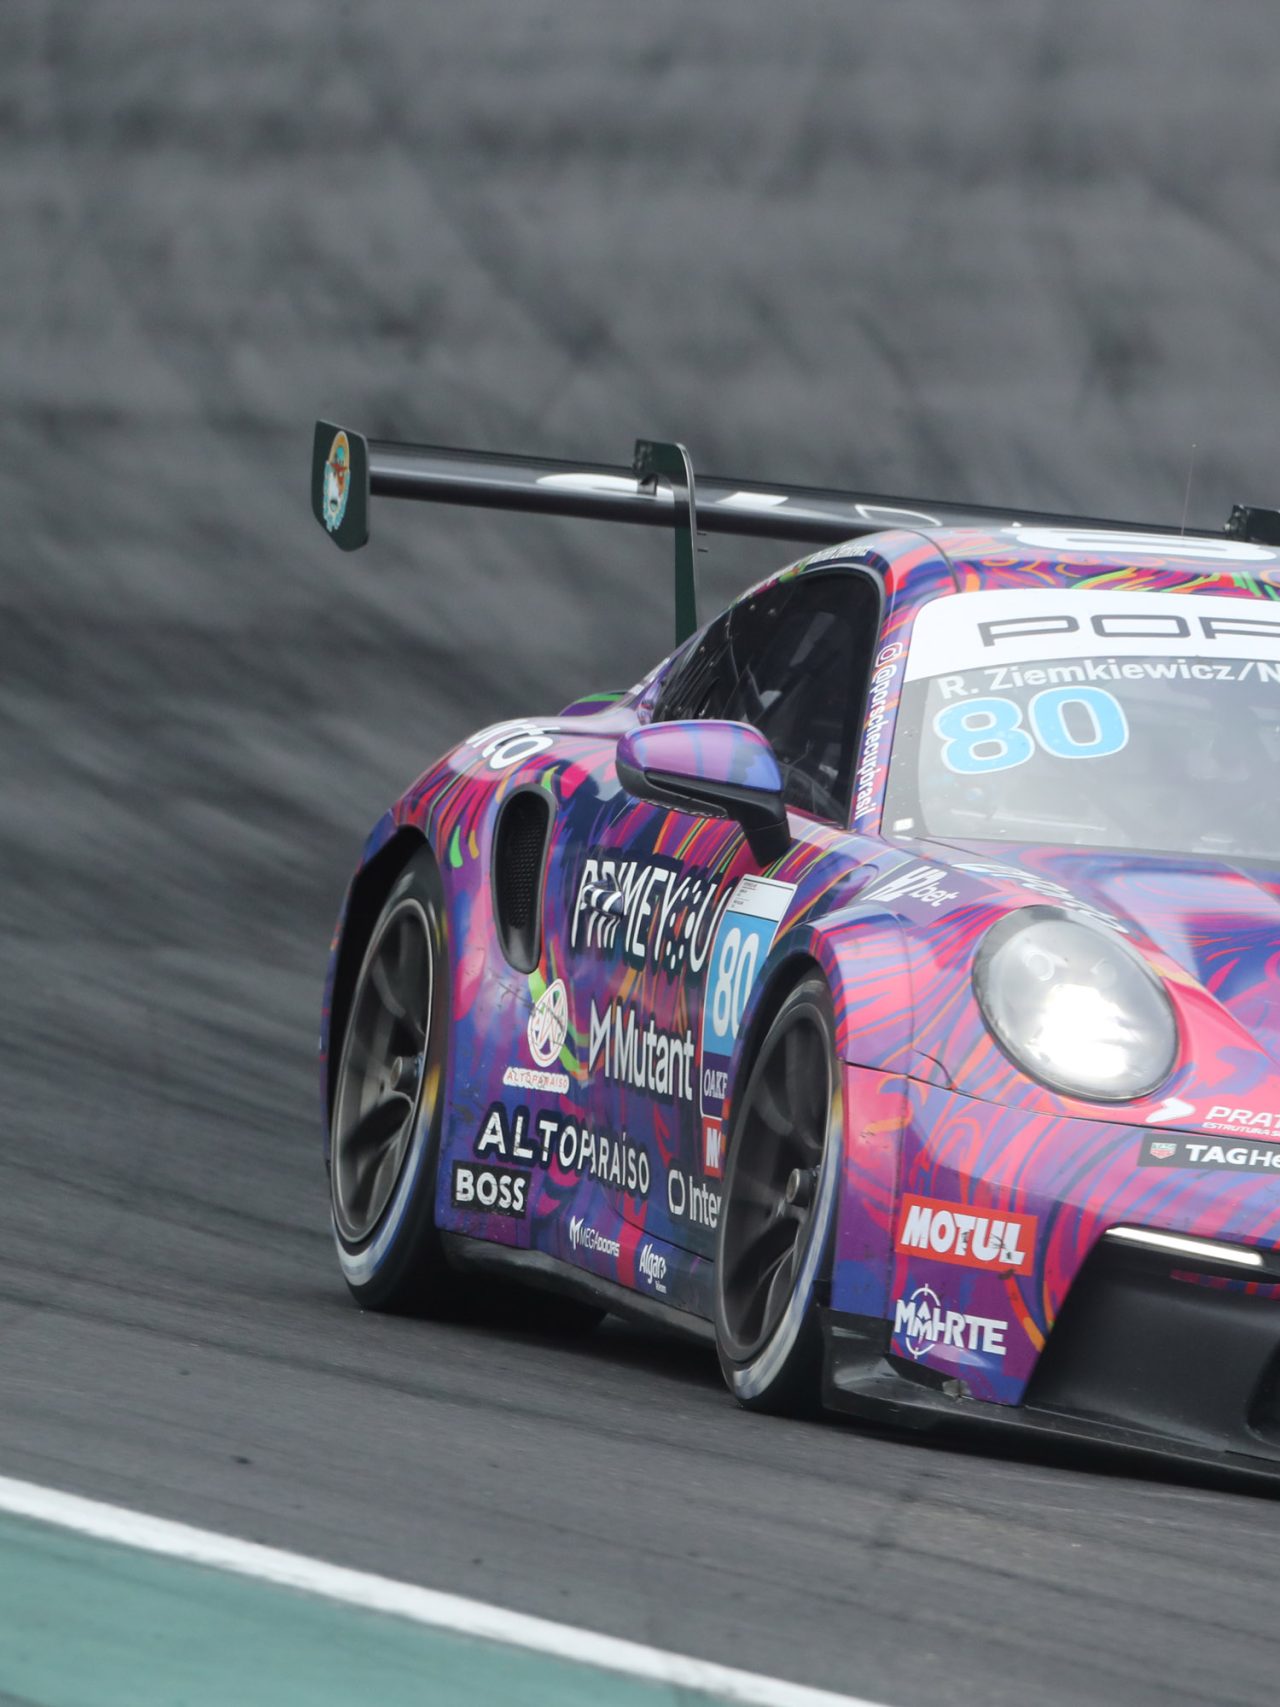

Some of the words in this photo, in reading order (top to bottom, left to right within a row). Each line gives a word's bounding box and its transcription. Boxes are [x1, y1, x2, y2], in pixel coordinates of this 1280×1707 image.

[938, 676, 980, 700] R.
[932, 685, 1130, 775] 80
[712, 927, 760, 1040] 80
[614, 1004, 695, 1101] Mutant
[456, 1168, 527, 1212] BOSS
[901, 1205, 1025, 1265] MOTUL
